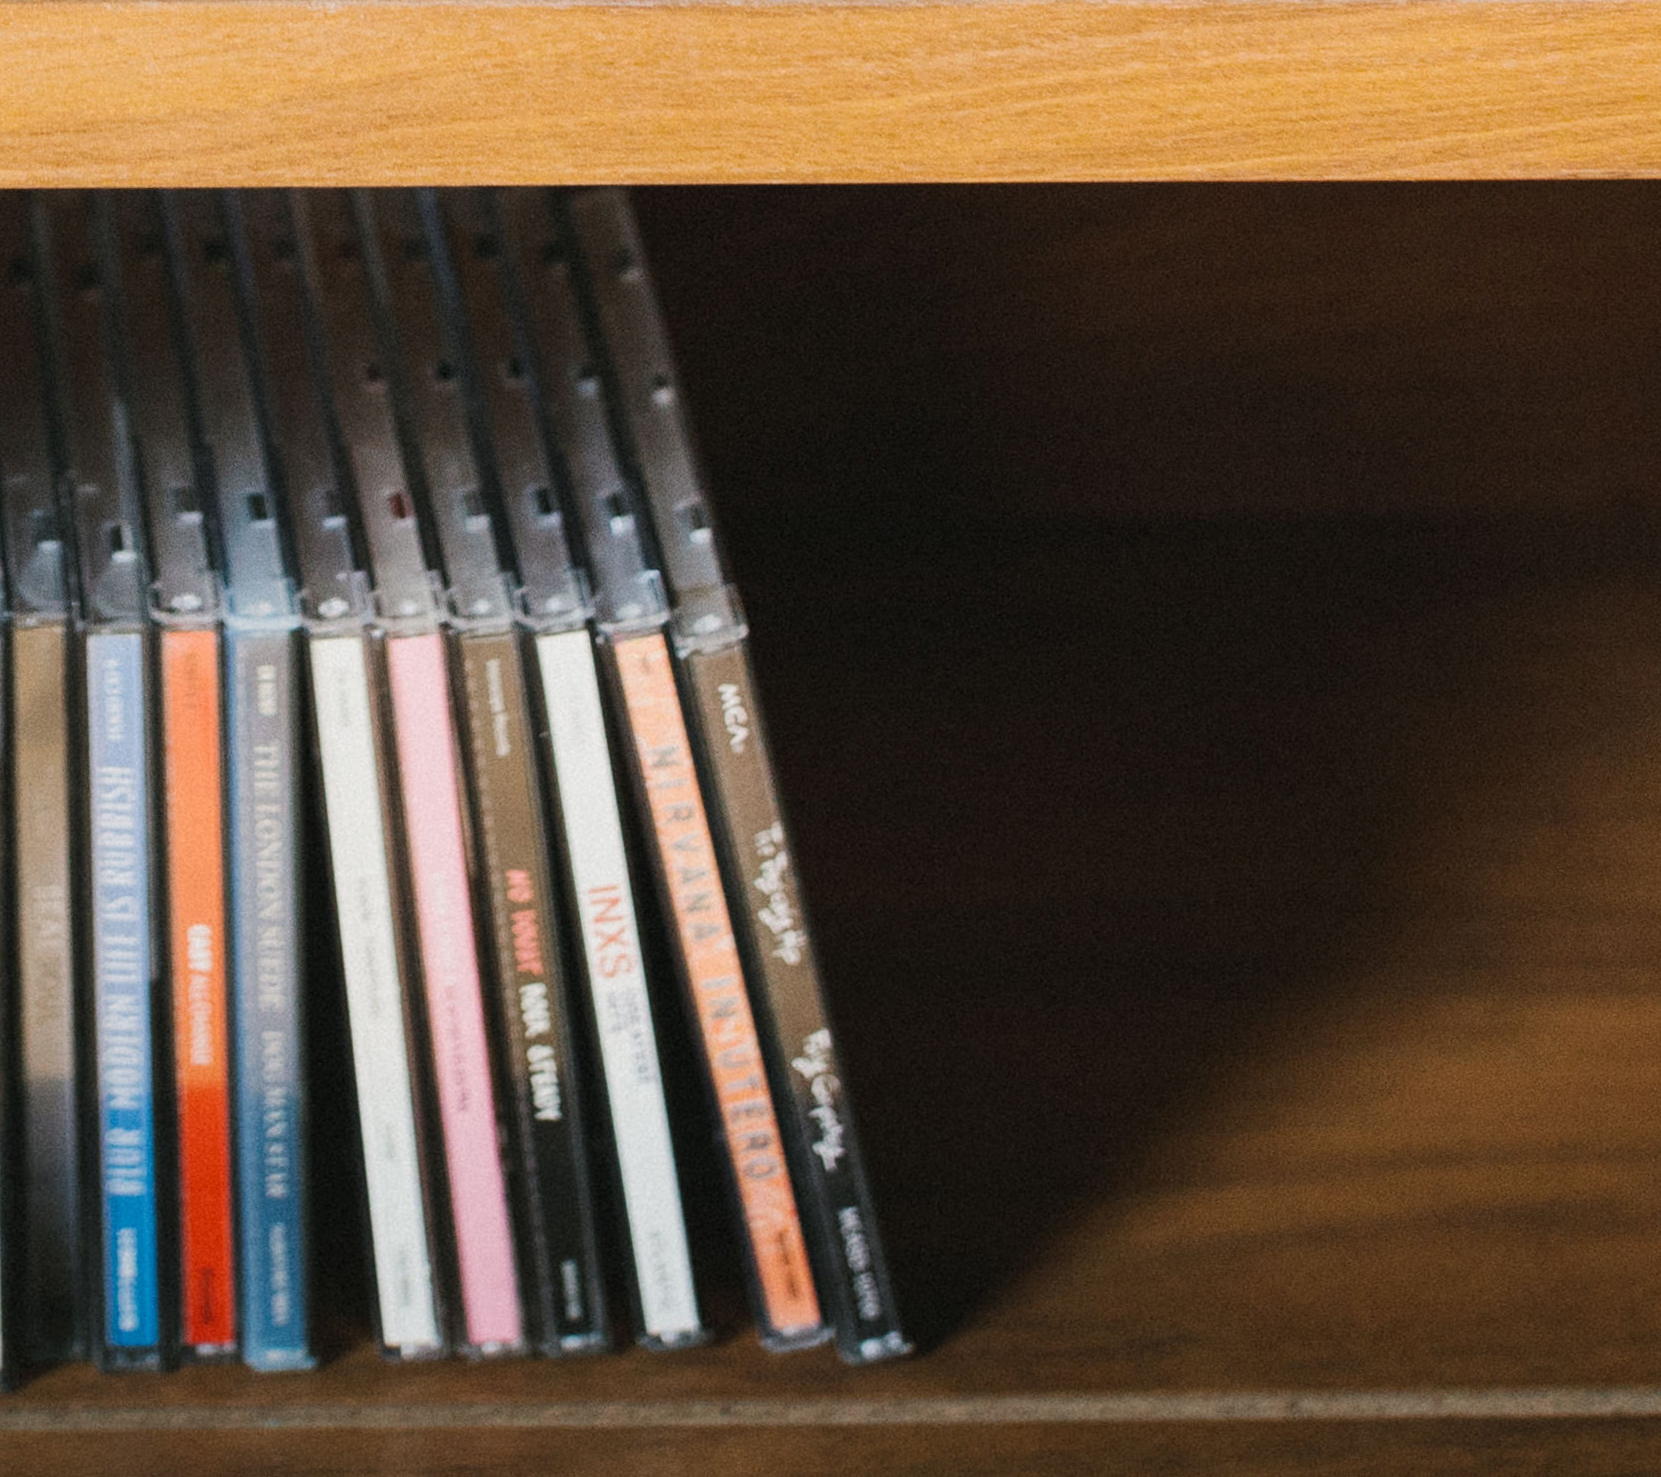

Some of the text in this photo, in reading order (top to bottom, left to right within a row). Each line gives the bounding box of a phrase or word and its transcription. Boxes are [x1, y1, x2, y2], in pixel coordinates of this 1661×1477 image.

[718, 683, 750, 748] MCA
[251, 741, 281, 792] THE
[96, 765, 138, 886] RUBBISH
[252, 802, 284, 919] LONDON
[503, 869, 535, 902] NO
[99, 895, 139, 921] IS
[586, 884, 633, 977] INXS
[100, 934, 140, 983] LIFE
[255, 926, 286, 1011] SUEDE
[648, 745, 781, 1179] NIRVANA IN UTERO
[100, 994, 143, 1109] MODERN
[104, 1127, 146, 1196] BLUR
[263, 1143, 288, 1199] STAR
